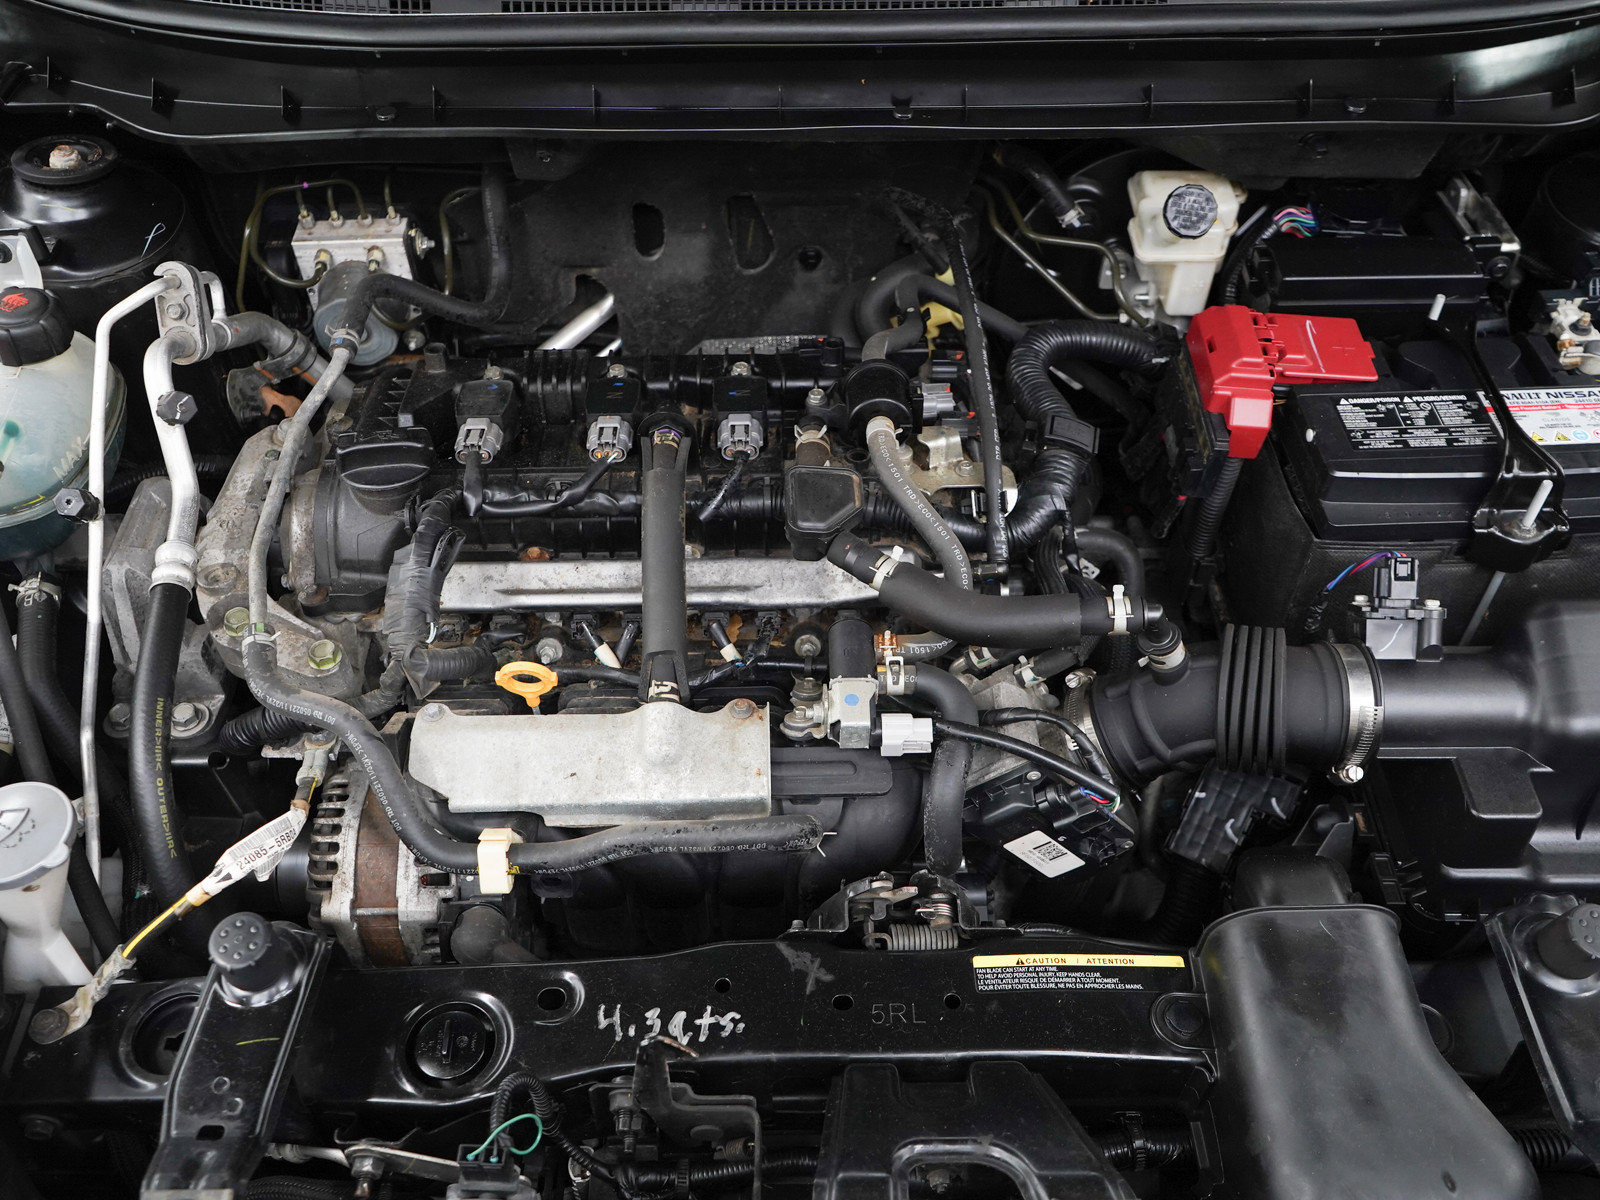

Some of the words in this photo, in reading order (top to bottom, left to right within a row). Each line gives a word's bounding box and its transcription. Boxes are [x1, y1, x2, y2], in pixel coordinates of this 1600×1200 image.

[1500, 392, 1541, 400] NAULT
[1546, 390, 1600, 399] NISSA
[1086, 957, 1135, 965] ATTENTION
[871, 1003, 927, 1025] 5RL
